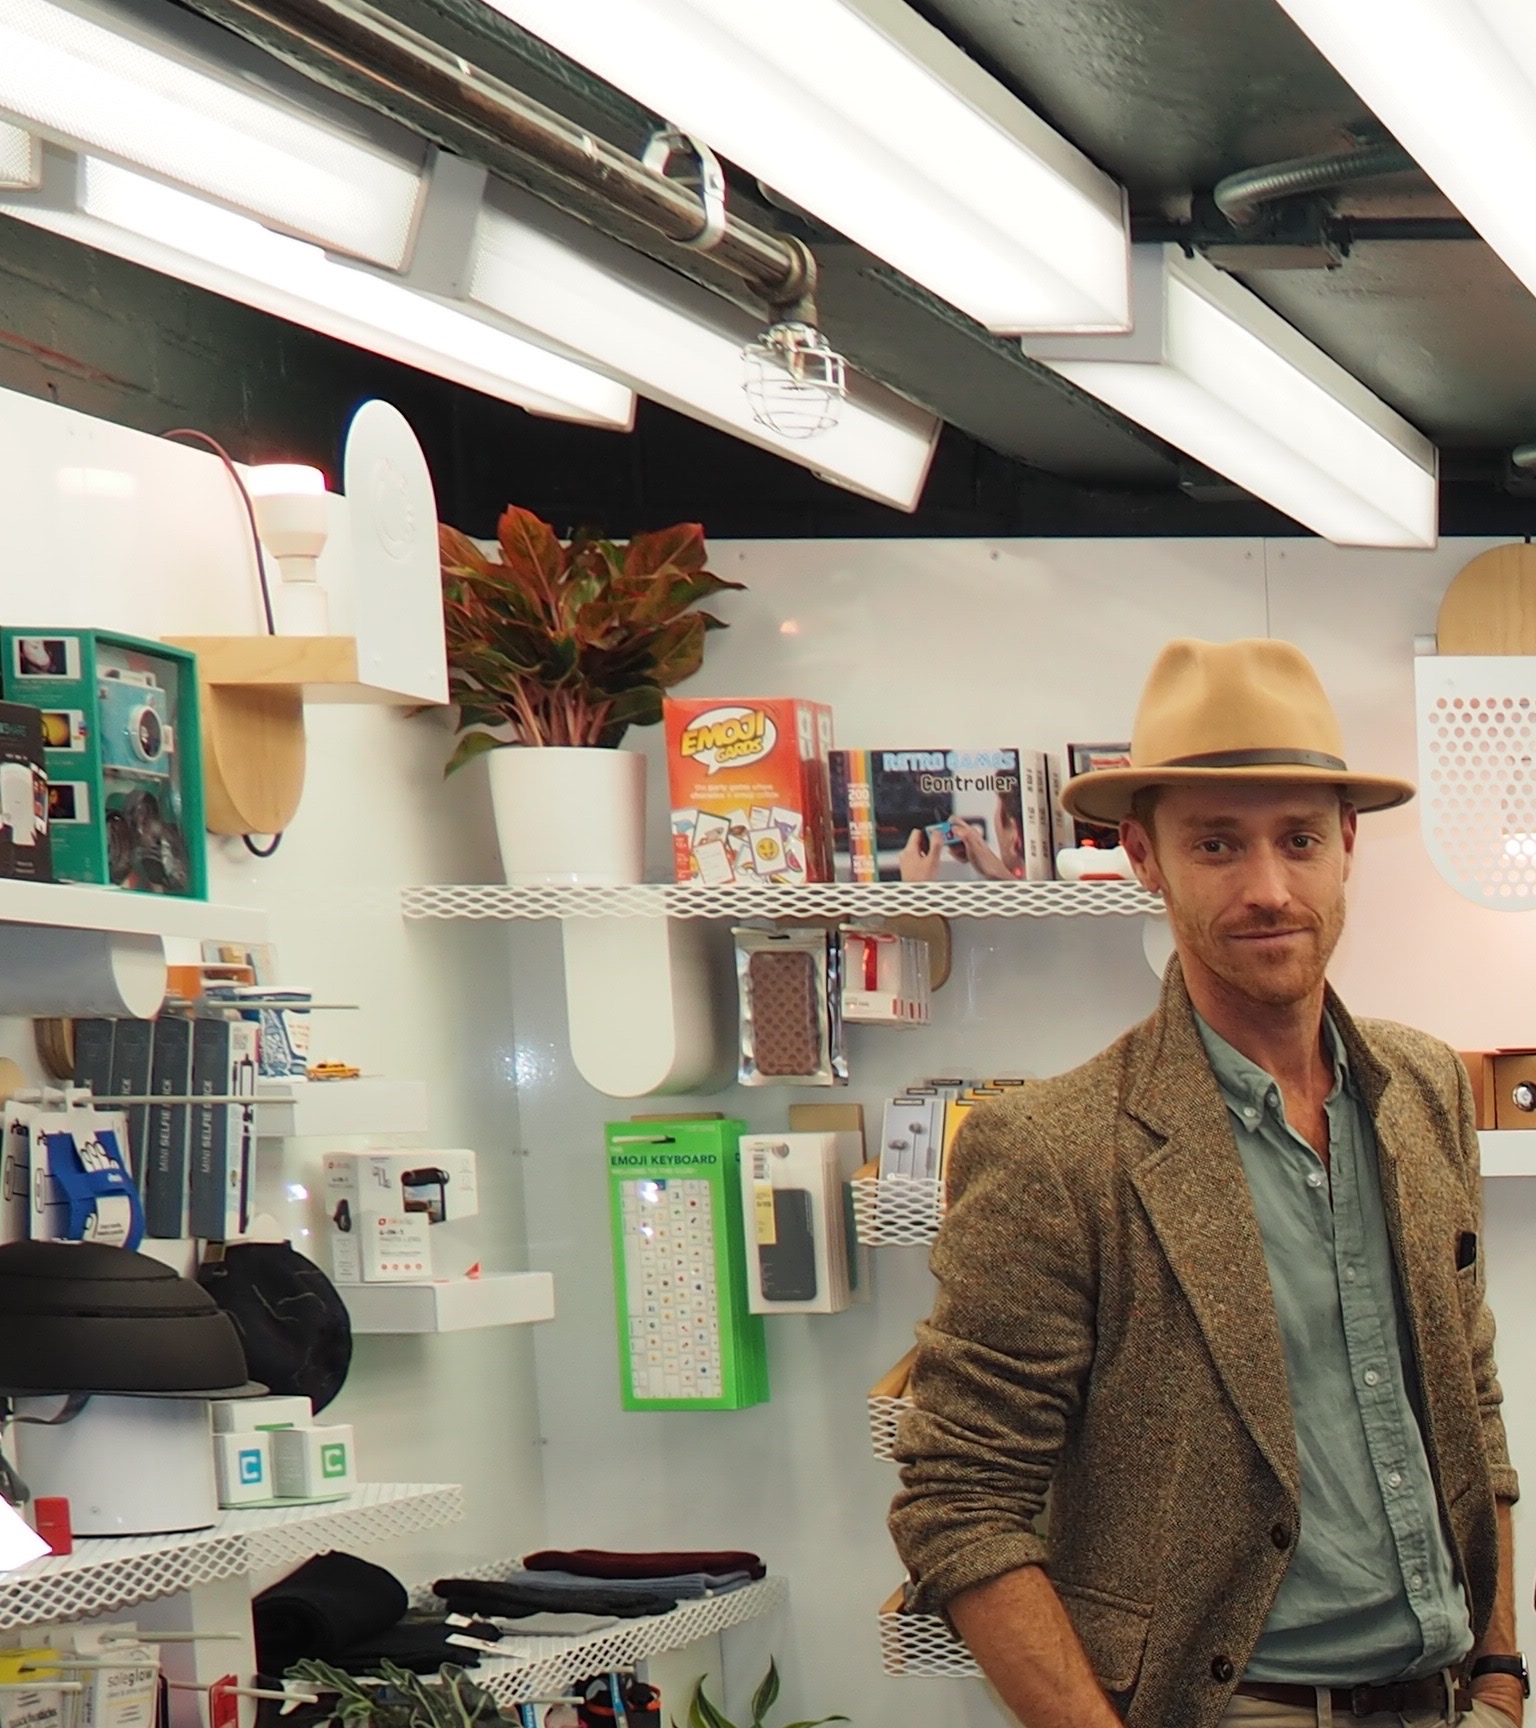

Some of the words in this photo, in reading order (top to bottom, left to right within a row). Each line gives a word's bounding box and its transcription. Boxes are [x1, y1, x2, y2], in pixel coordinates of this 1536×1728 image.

[680, 710, 766, 757] EMOJI
[921, 774, 1017, 793] Controller
[610, 1155, 647, 1166] EMOJI
[651, 1155, 717, 1165] KEYBOARD
